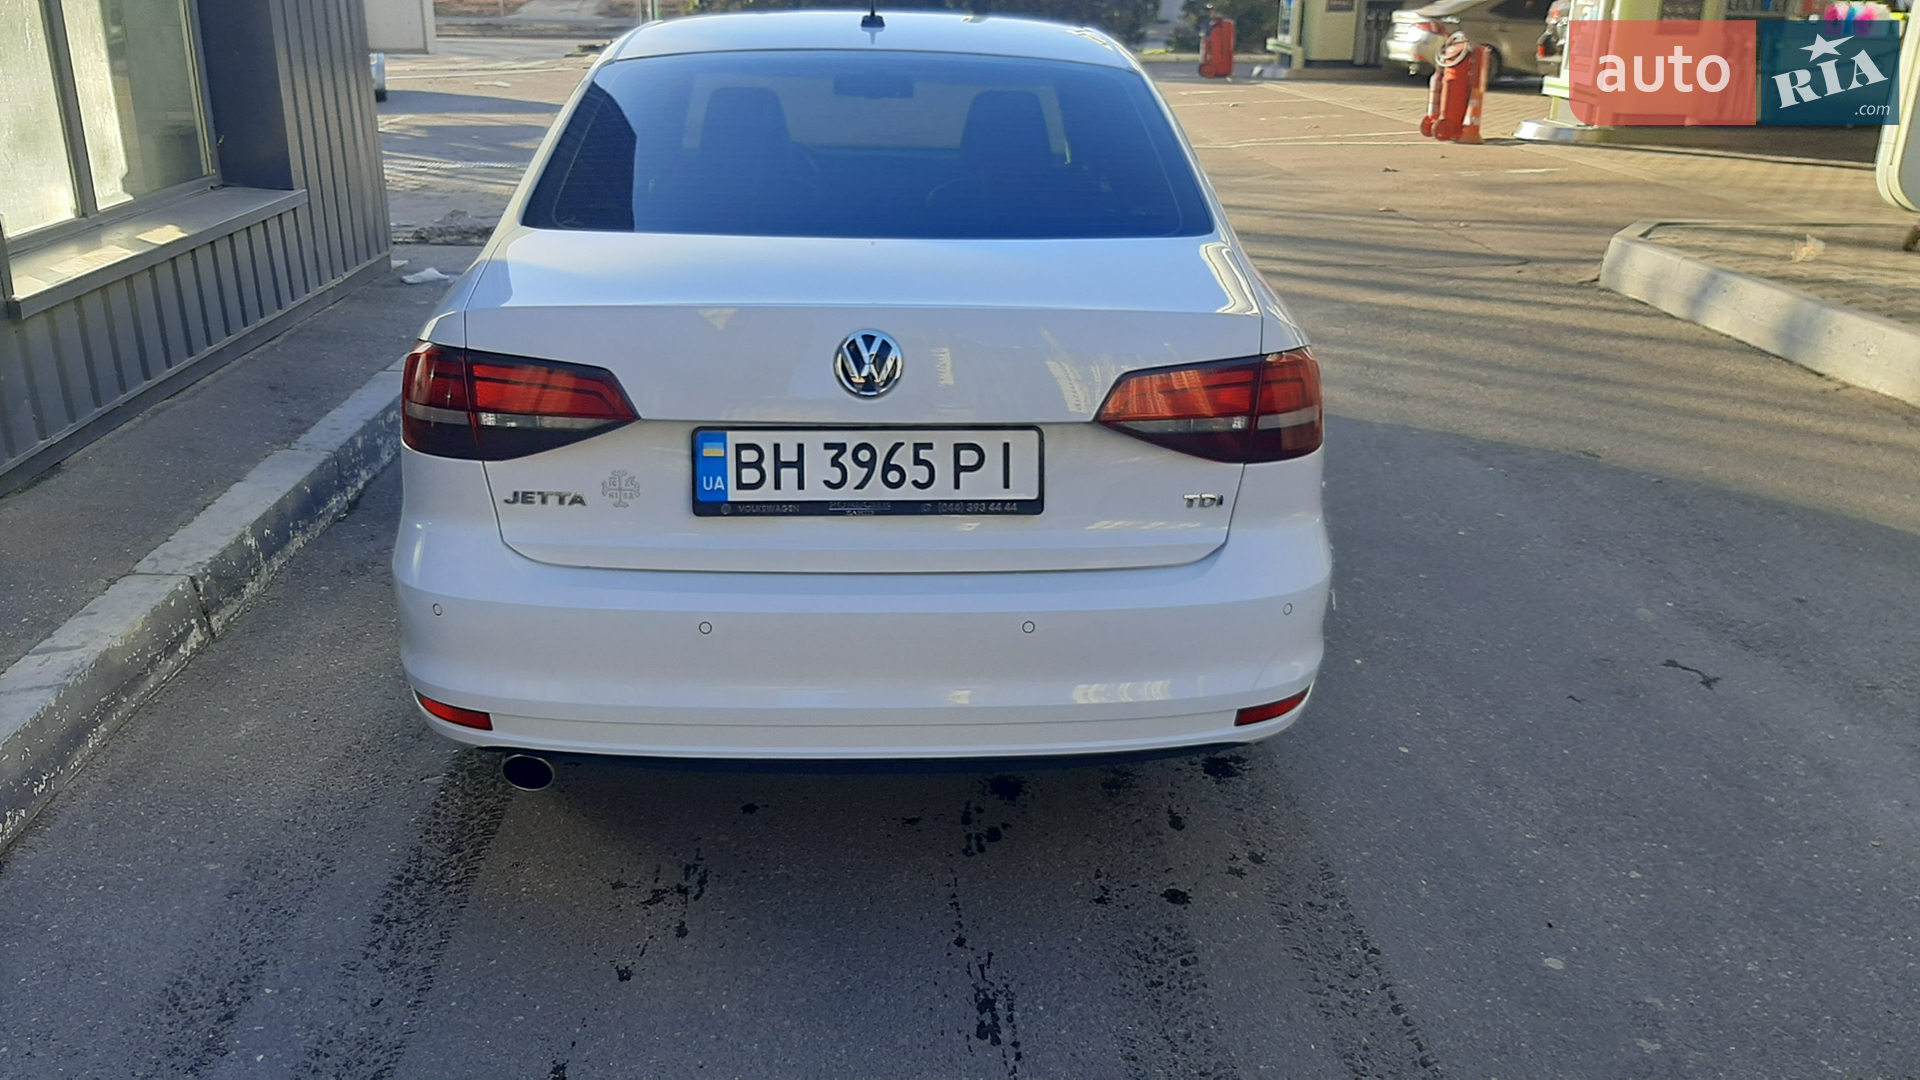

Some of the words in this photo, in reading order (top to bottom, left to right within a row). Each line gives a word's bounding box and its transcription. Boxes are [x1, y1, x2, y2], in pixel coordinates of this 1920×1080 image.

[735, 442, 806, 491] BH
[823, 442, 936, 490] 3965
[703, 476, 725, 491] UA
[504, 491, 587, 506] JETTA
[1183, 494, 1224, 508] TDI
[738, 504, 800, 513] VOLKSWAGEN
[966, 502, 986, 512] 393
[988, 502, 1003, 512] 44
[1004, 502, 1018, 512] 44
